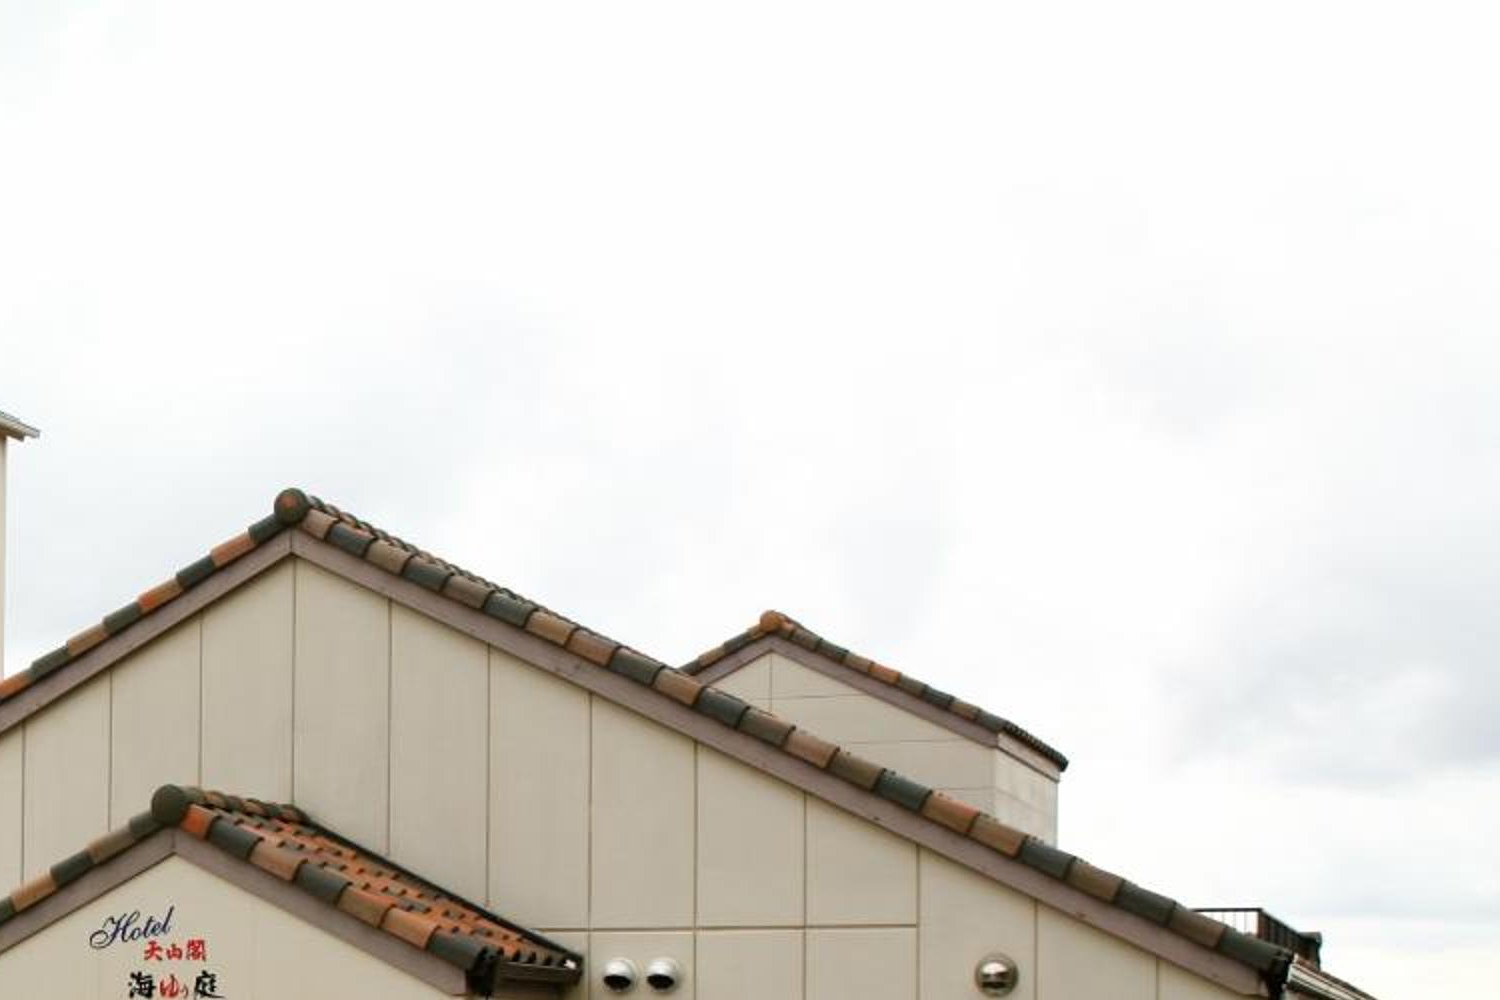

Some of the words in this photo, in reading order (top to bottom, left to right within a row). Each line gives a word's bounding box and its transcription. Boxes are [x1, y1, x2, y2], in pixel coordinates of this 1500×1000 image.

[89, 904, 175, 949] Hotel
[143, 938, 207, 962] 天山閣
